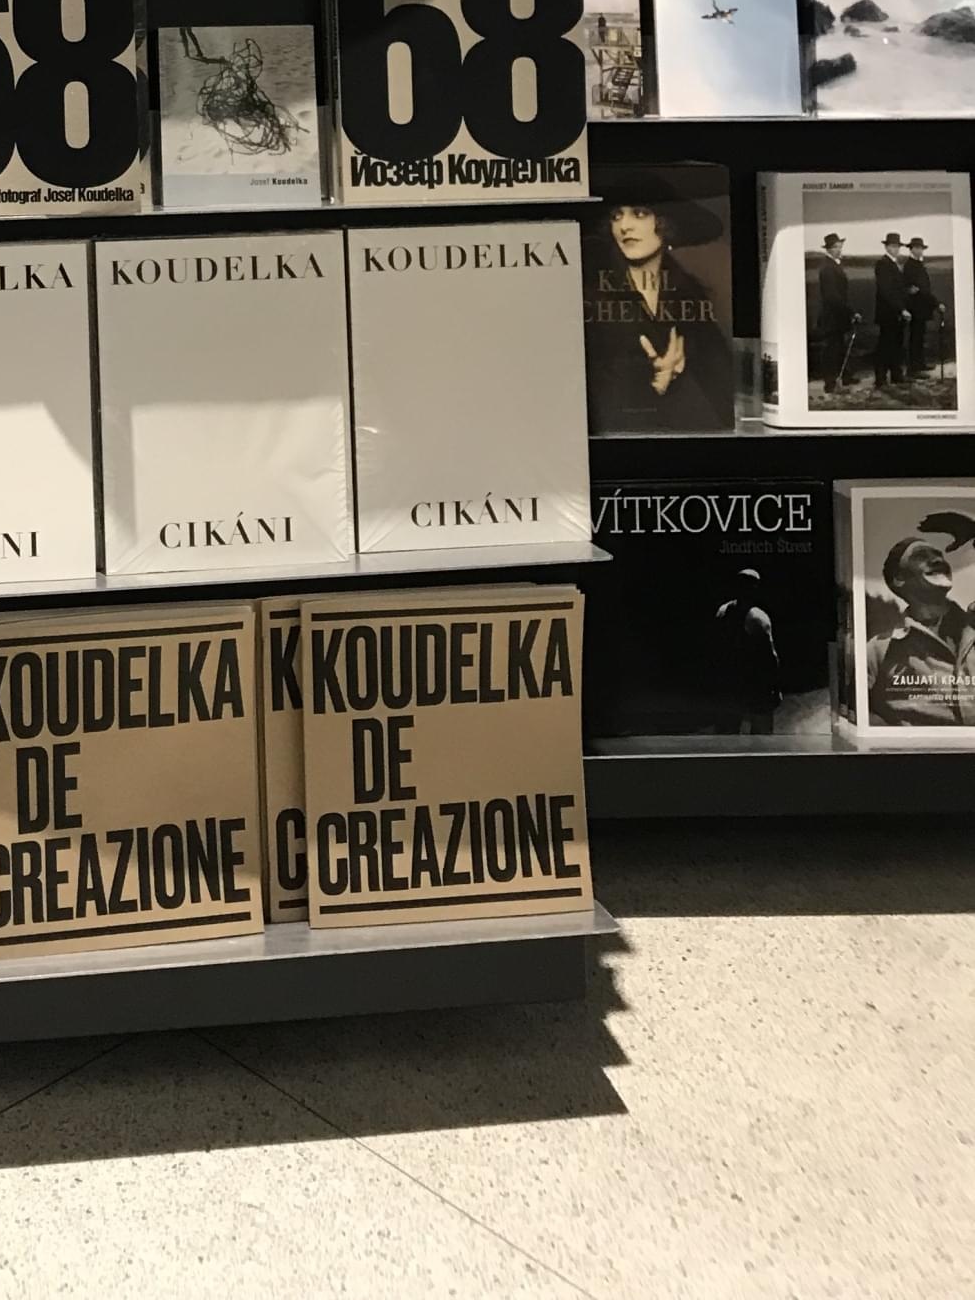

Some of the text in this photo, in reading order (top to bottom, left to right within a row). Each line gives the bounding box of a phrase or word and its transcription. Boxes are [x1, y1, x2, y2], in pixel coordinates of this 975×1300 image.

[272, 177, 308, 186] Koudelka
[350, 149, 580, 190] Йозеф Коуделка
[44, 187, 77, 202] Josef
[78, 186, 134, 202] Koudelka
[111, 251, 326, 287] KOUDELKA
[362, 241, 571, 273] KOUDELKA
[597, 269, 677, 292] KARL
[584, 300, 718, 322] CHENKER
[410, 492, 541, 529] CIKÁNI
[591, 488, 812, 534] VÍTKOVICE
[159, 512, 293, 550] CIKÁNI
[311, 618, 573, 715] KOUDELKA
[351, 715, 416, 804] DE
[16, 741, 82, 835] DE
[317, 793, 580, 896] CREAZIONE
